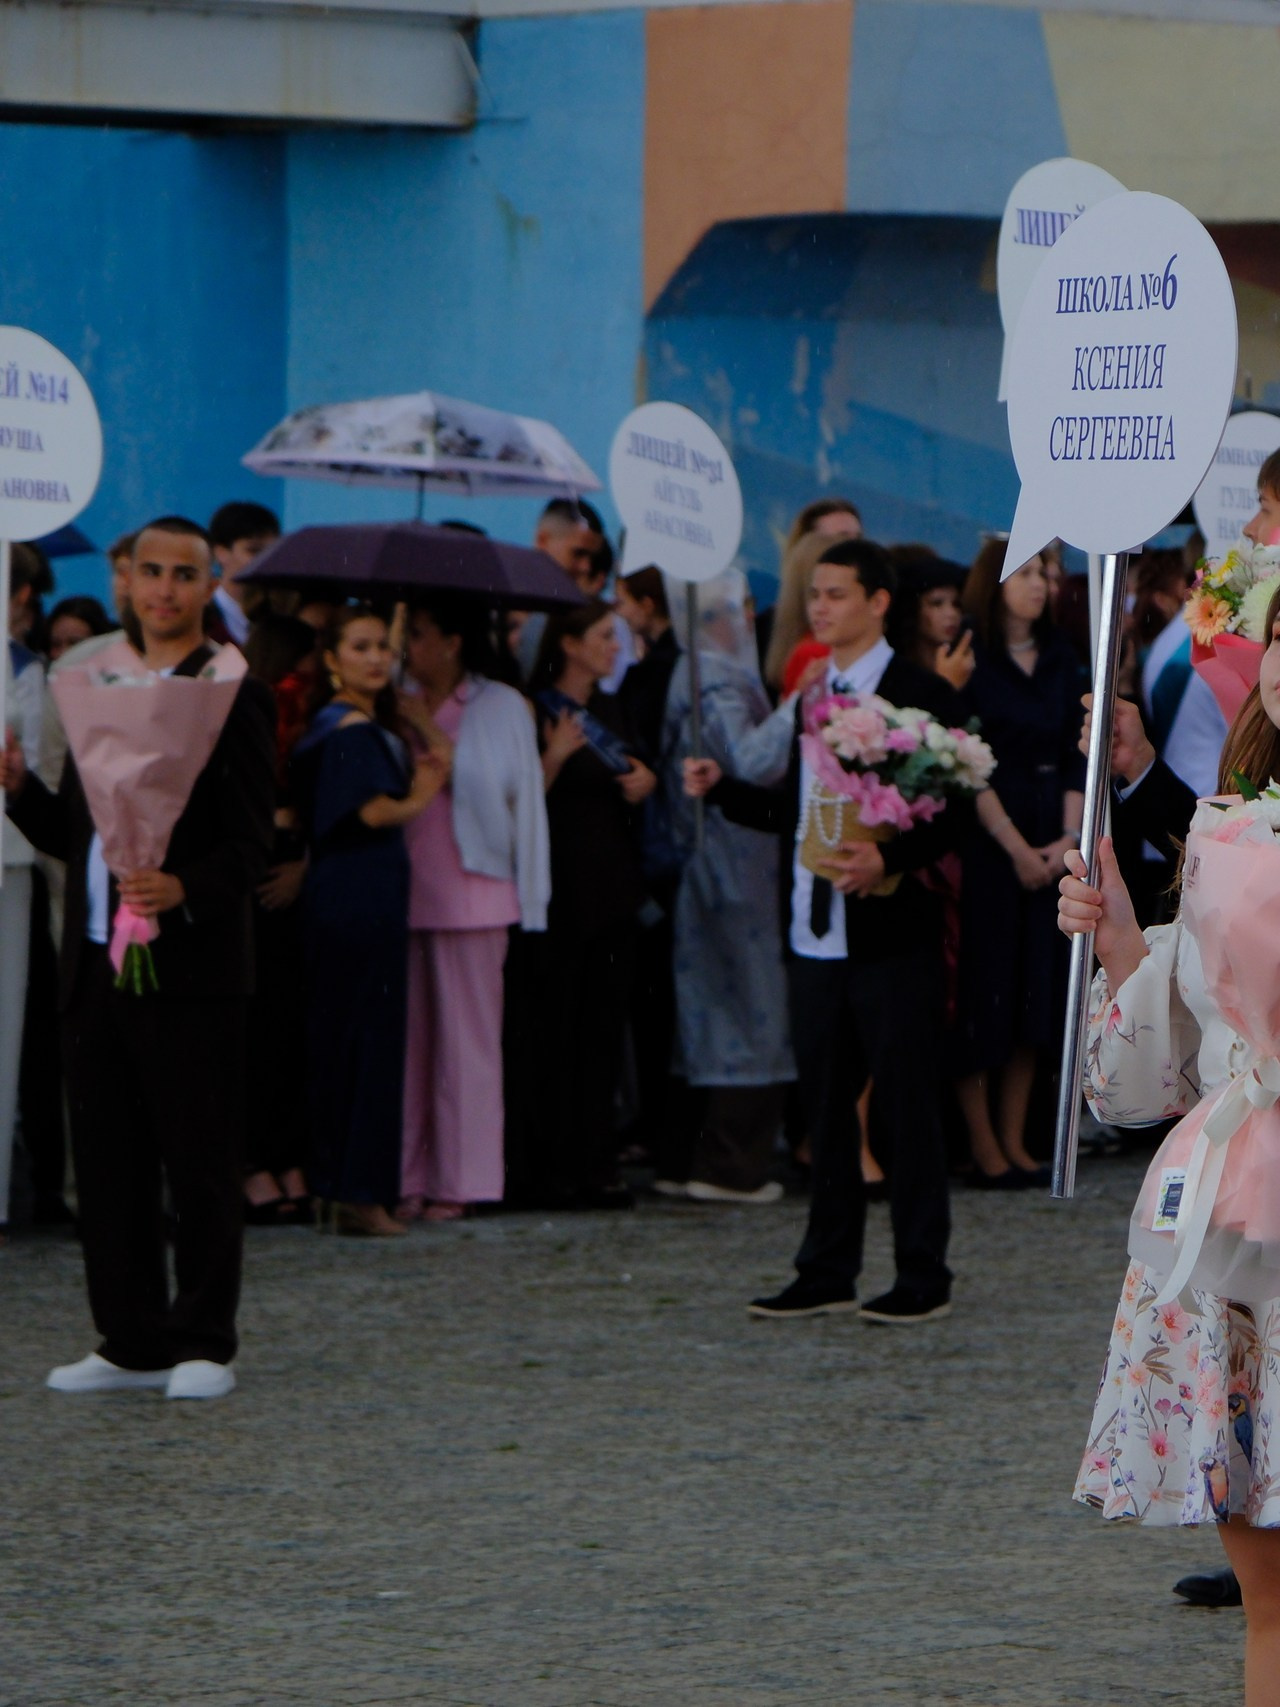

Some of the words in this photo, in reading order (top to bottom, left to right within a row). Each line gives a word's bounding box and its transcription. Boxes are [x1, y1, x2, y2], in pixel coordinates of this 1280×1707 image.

[1056, 275, 1134, 314] ШКОЛА
[1138, 253, 1179, 311] №6
[1071, 344, 1166, 391] КСЕНИЯ
[1050, 415, 1176, 462] СЕРГЕЕВНА
